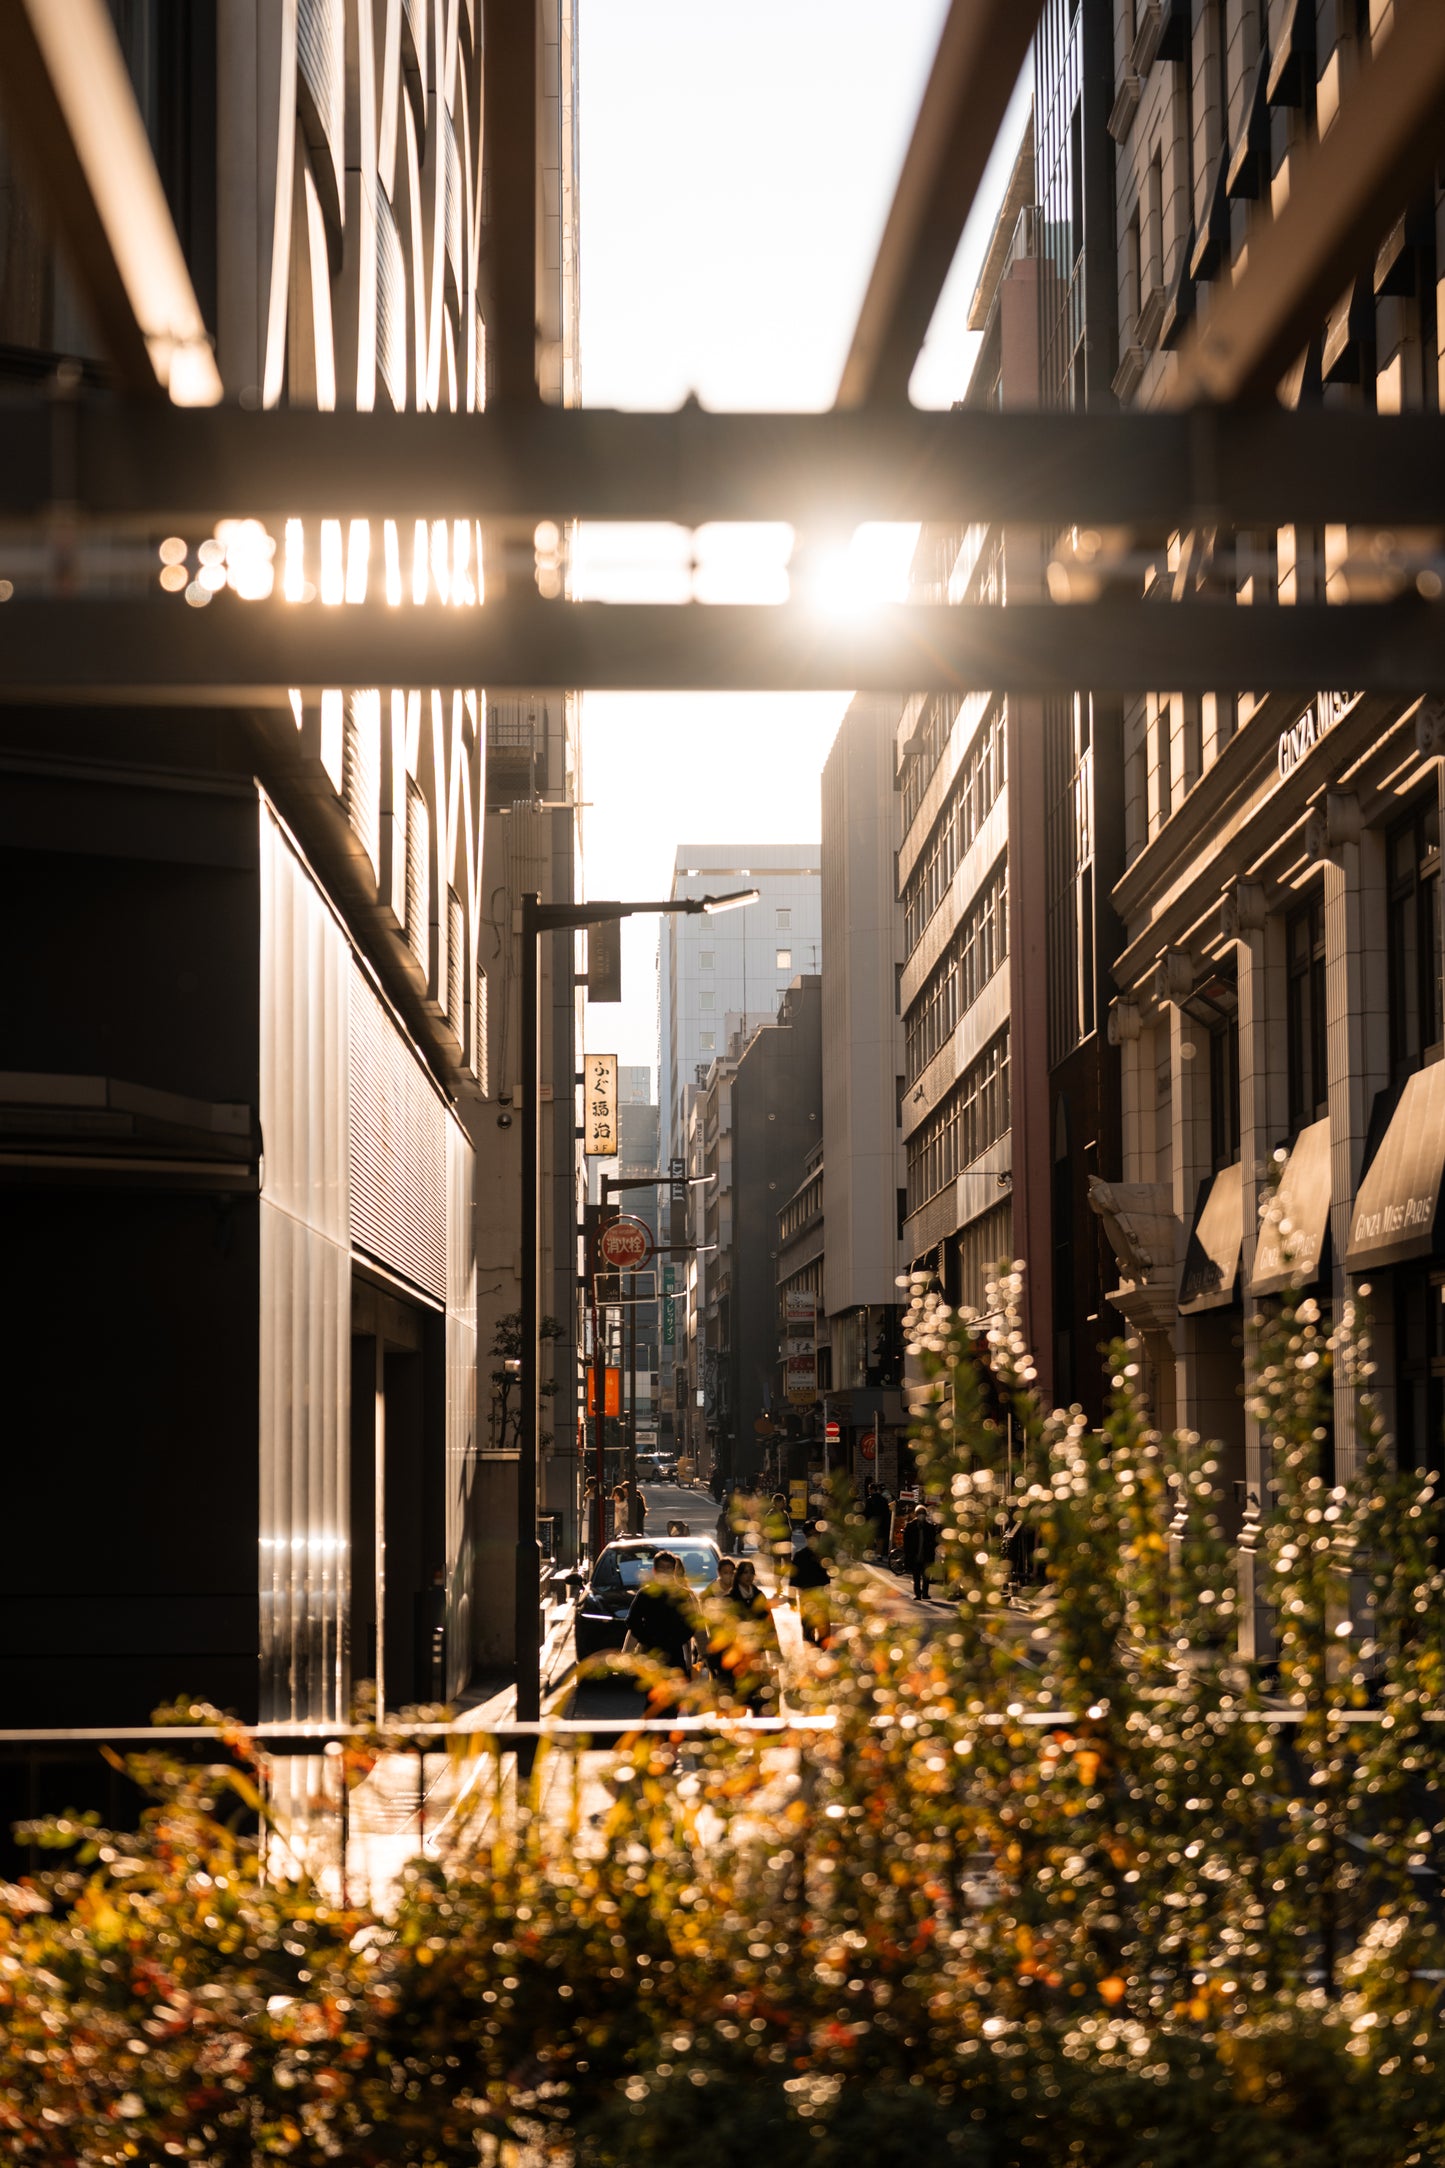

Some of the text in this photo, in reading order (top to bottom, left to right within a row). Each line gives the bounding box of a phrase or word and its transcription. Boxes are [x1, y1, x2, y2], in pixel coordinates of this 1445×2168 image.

[1278, 708, 1315, 780] GINZA
[1355, 1196, 1432, 1242] GINZA MISS PARIS
[607, 1236, 642, 1254] 消火栓
